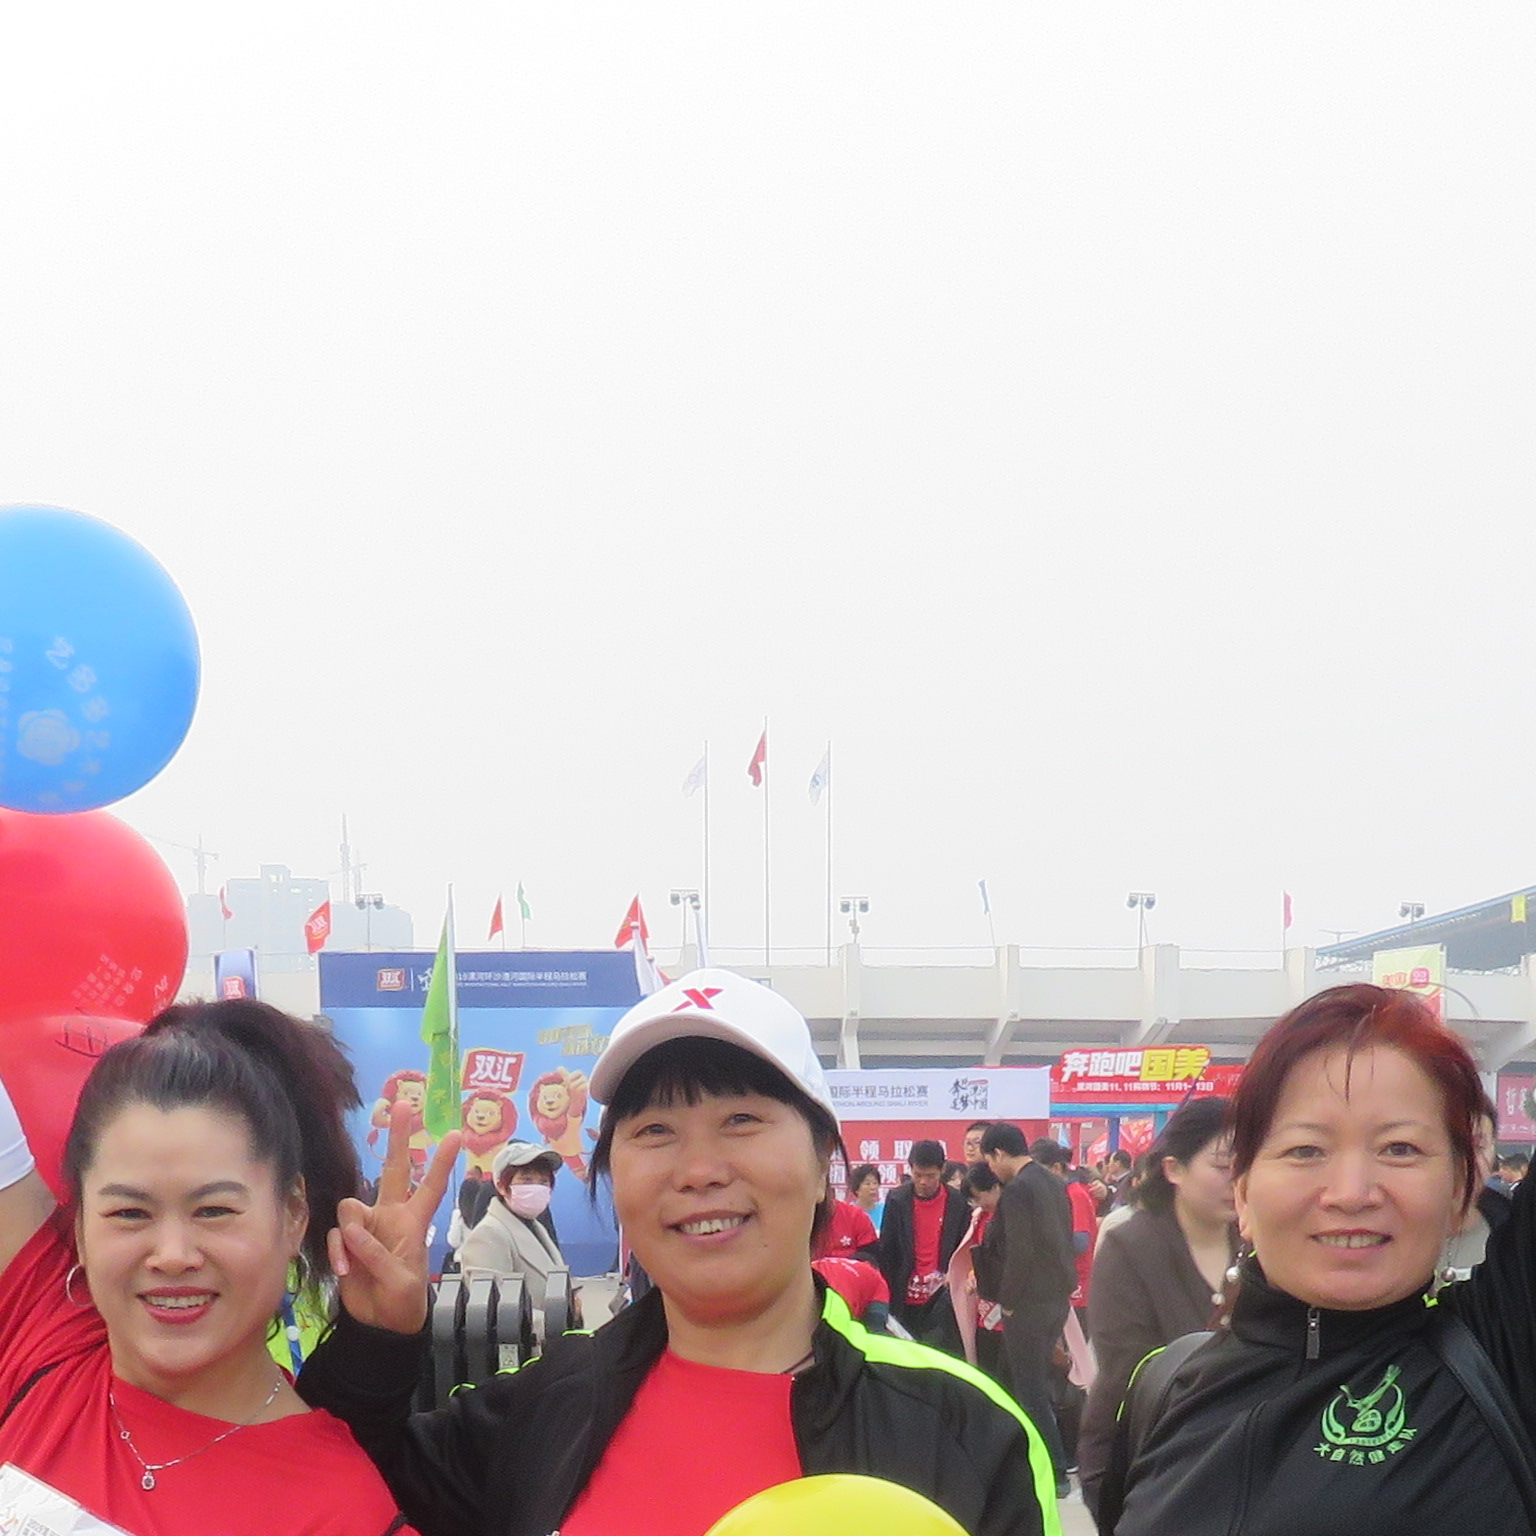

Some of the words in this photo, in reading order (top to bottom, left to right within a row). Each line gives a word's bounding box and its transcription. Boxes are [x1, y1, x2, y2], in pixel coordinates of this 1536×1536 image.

[469, 1054, 517, 1082] 双汇
[1061, 1048, 1210, 1083] 奔跑吧国美
